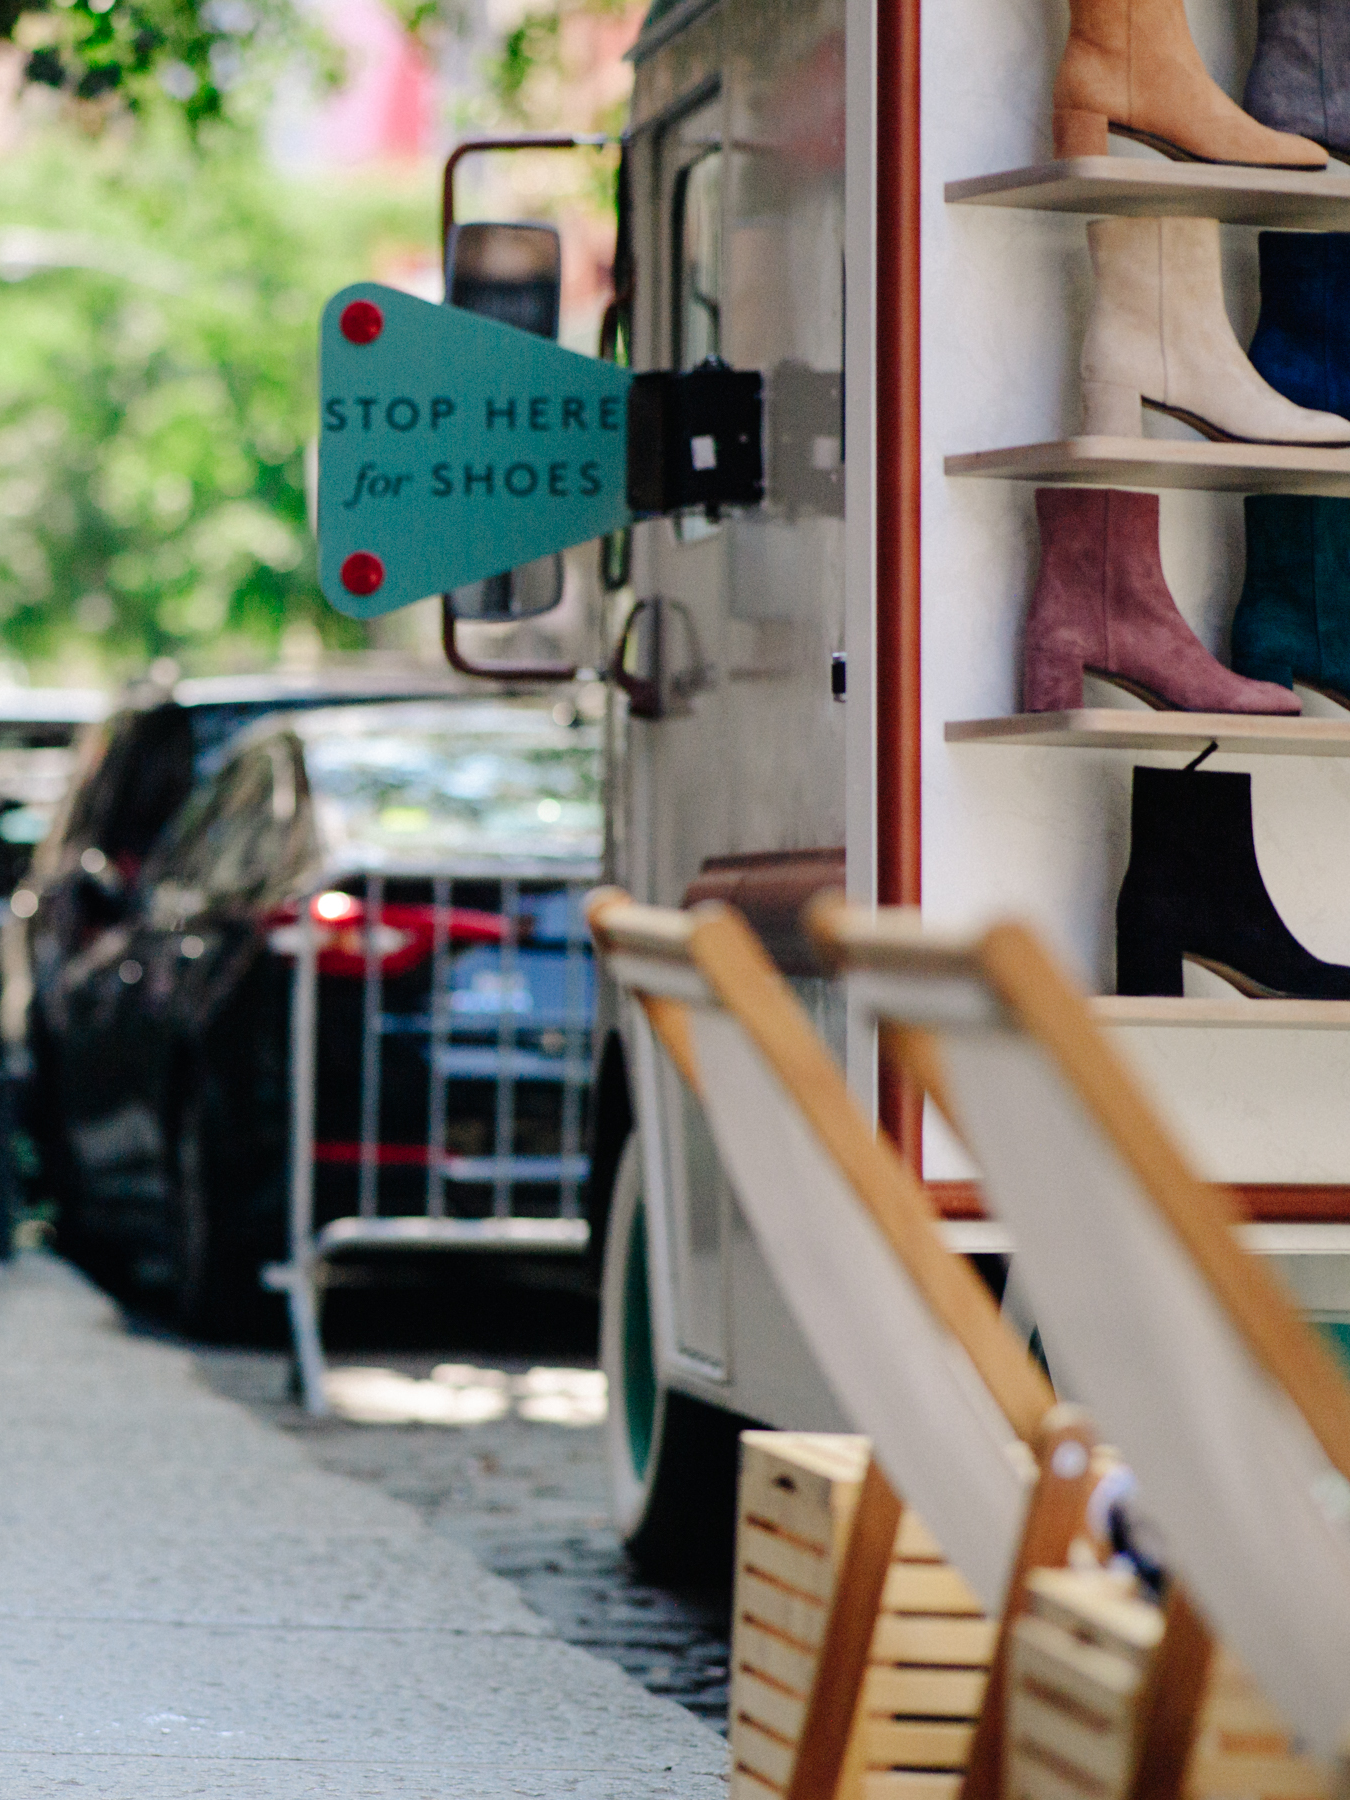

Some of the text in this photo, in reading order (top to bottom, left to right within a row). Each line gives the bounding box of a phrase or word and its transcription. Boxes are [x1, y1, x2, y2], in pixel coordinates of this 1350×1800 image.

[325, 397, 624, 432] STOP HERE
[343, 461, 601, 509] for SHOES
